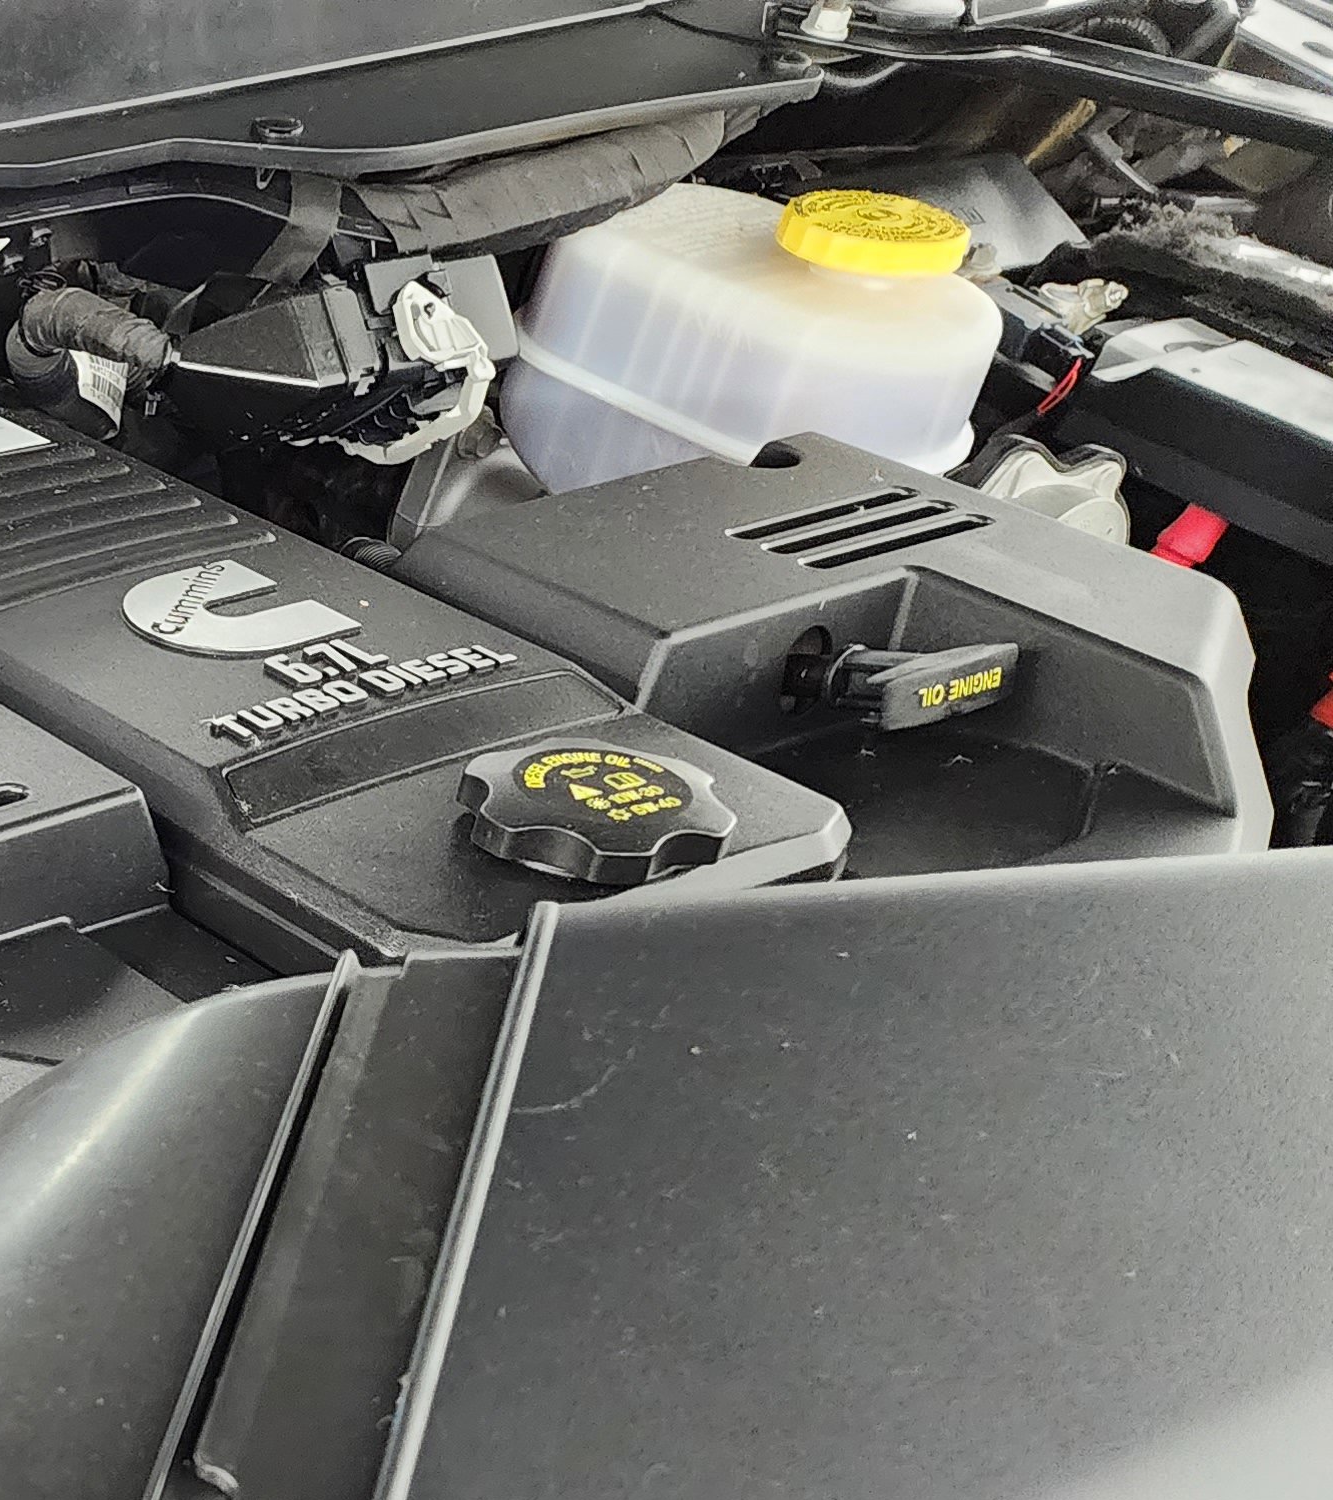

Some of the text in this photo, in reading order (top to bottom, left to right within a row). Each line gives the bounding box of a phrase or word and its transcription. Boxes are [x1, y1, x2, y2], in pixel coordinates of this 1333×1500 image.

[151, 561, 226, 635] Cummins
[263, 638, 389, 687] 6.7L
[919, 666, 1002, 707] ENGINE OIL
[210, 644, 520, 742] TURBO DIESEL
[604, 754, 632, 768] OIL
